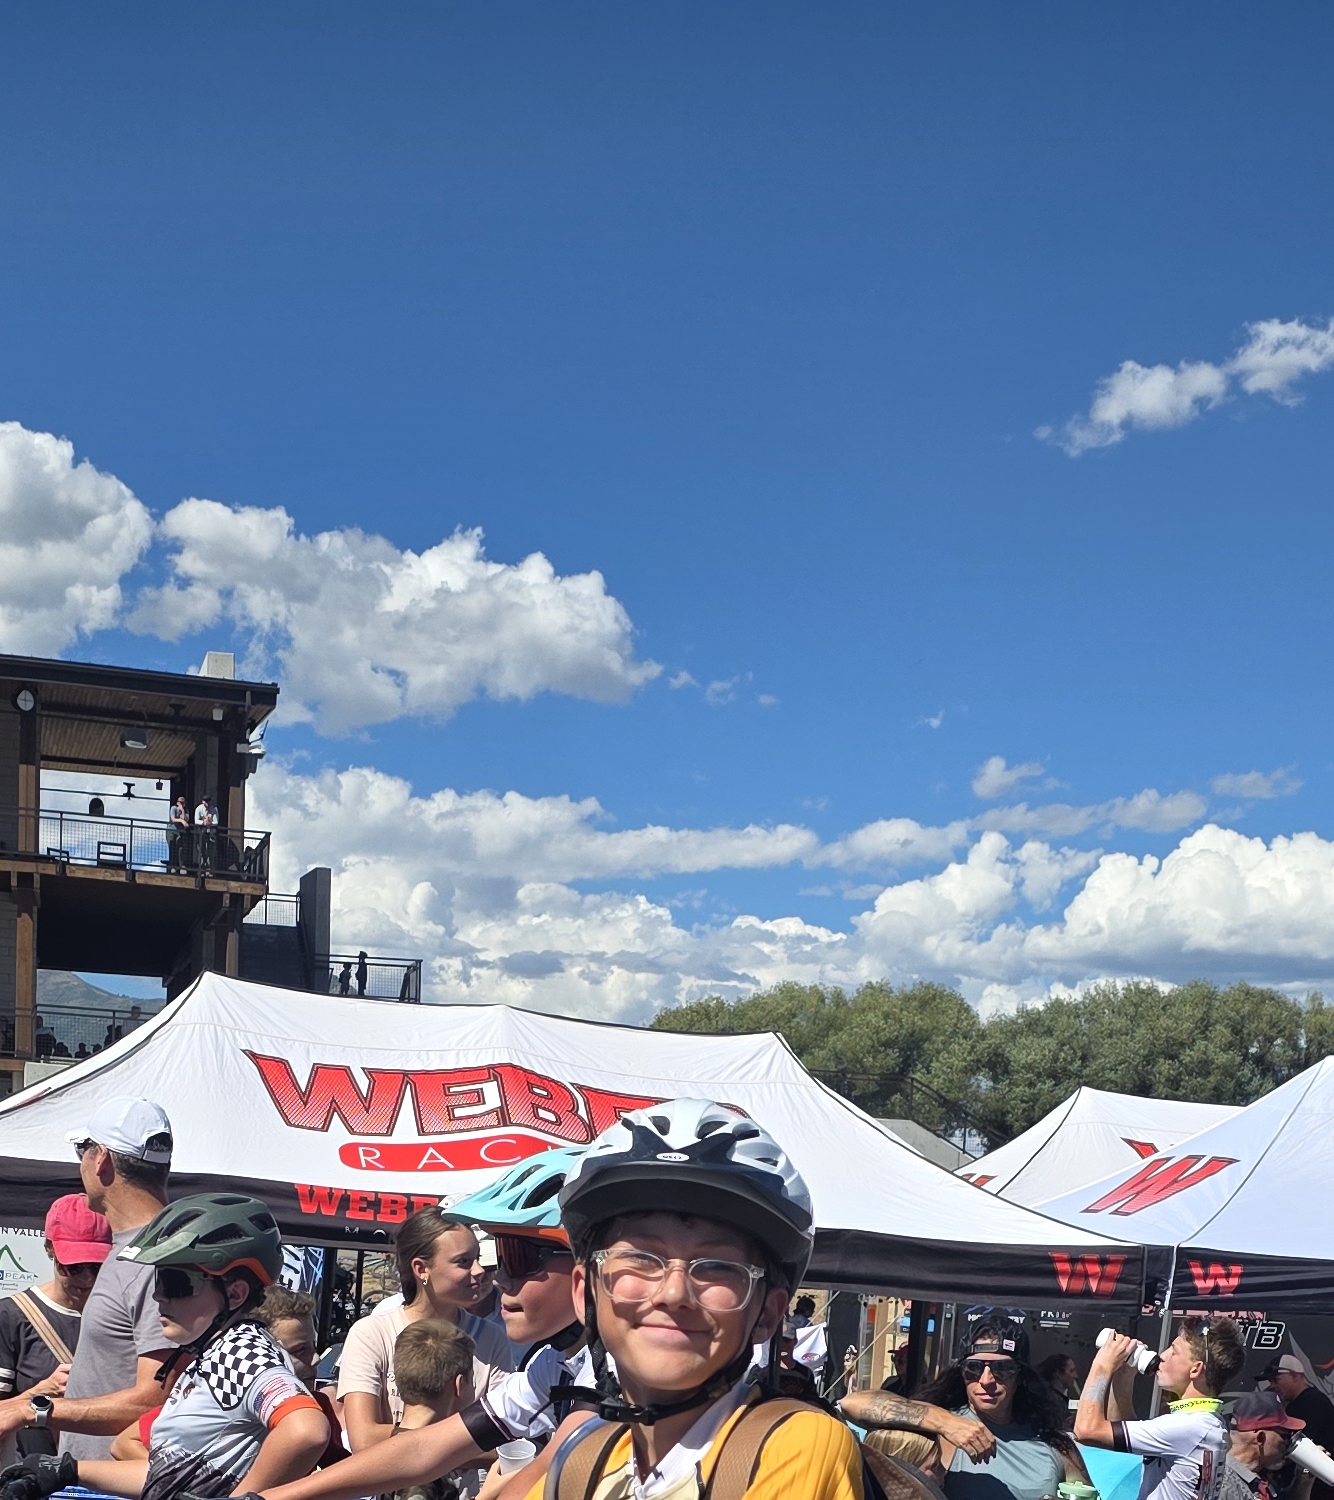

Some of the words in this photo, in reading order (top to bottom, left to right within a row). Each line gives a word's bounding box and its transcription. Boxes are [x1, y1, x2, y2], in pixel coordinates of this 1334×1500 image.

[359, 1137, 521, 1170] RAC
[1080, 1154, 1240, 1216] W
[14, 1227, 45, 1238] VALLE
[5, 1272, 34, 1281] PEAK
[1048, 1253, 1128, 1298] W
[1188, 1259, 1244, 1295] W
